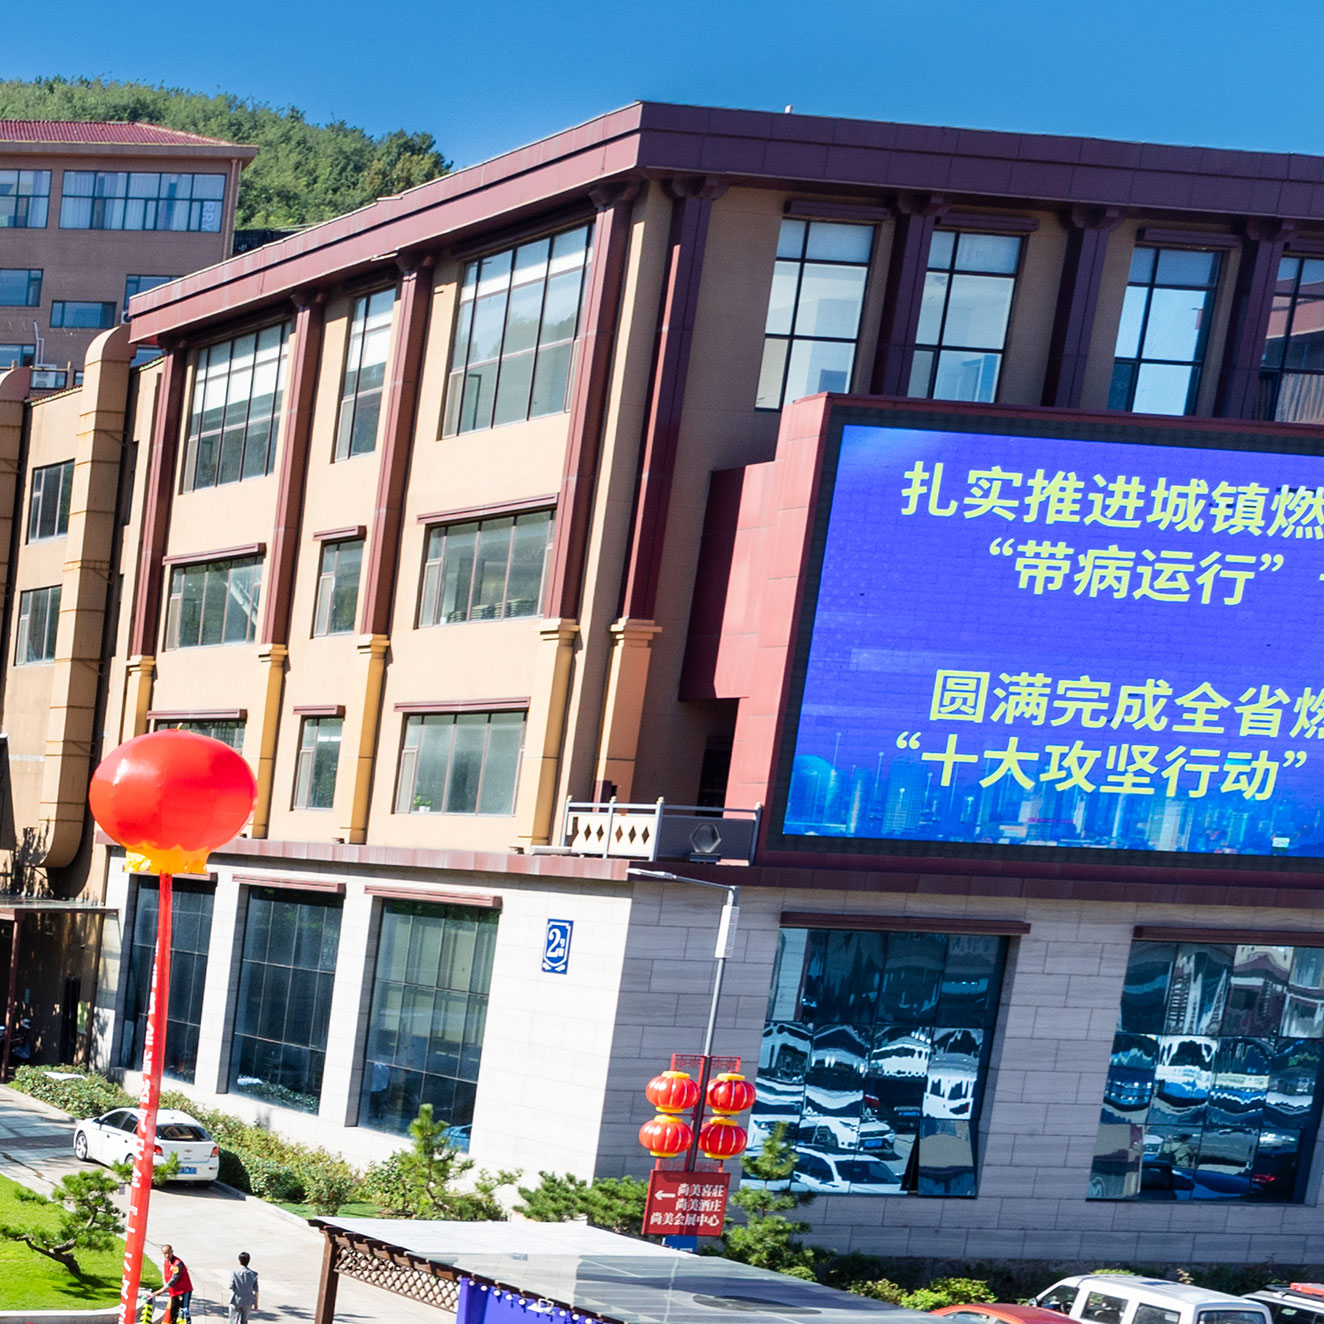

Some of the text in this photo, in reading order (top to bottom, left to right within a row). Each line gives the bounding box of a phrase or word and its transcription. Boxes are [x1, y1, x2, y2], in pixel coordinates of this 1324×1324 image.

[901, 460, 1324, 540] 扎实推进城镇燃
[989, 537, 1284, 606] “带病运行”
[895, 731, 1307, 801] “十大攻坚行动”
[649, 1211, 721, 1227] 尚美会展中心
